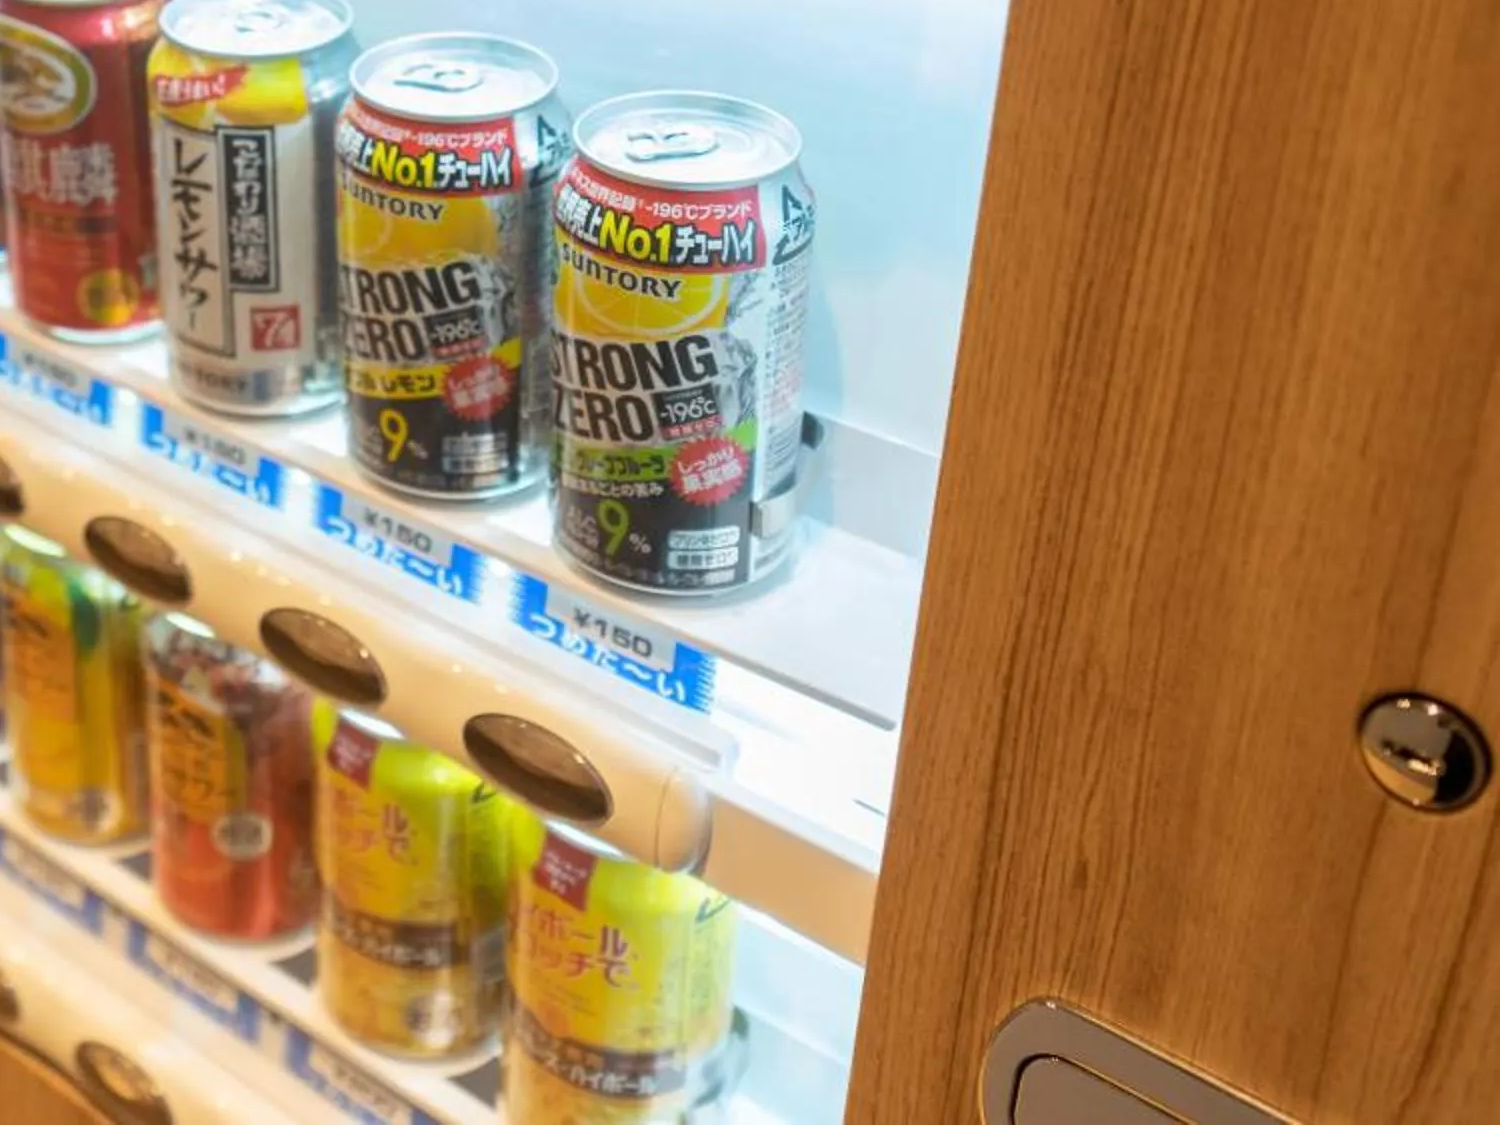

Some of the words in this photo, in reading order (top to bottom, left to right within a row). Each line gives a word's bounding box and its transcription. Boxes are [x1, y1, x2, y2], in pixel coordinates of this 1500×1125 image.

[170, 136, 218, 330] レモンサワー
[572, 605, 655, 659] ¥150
